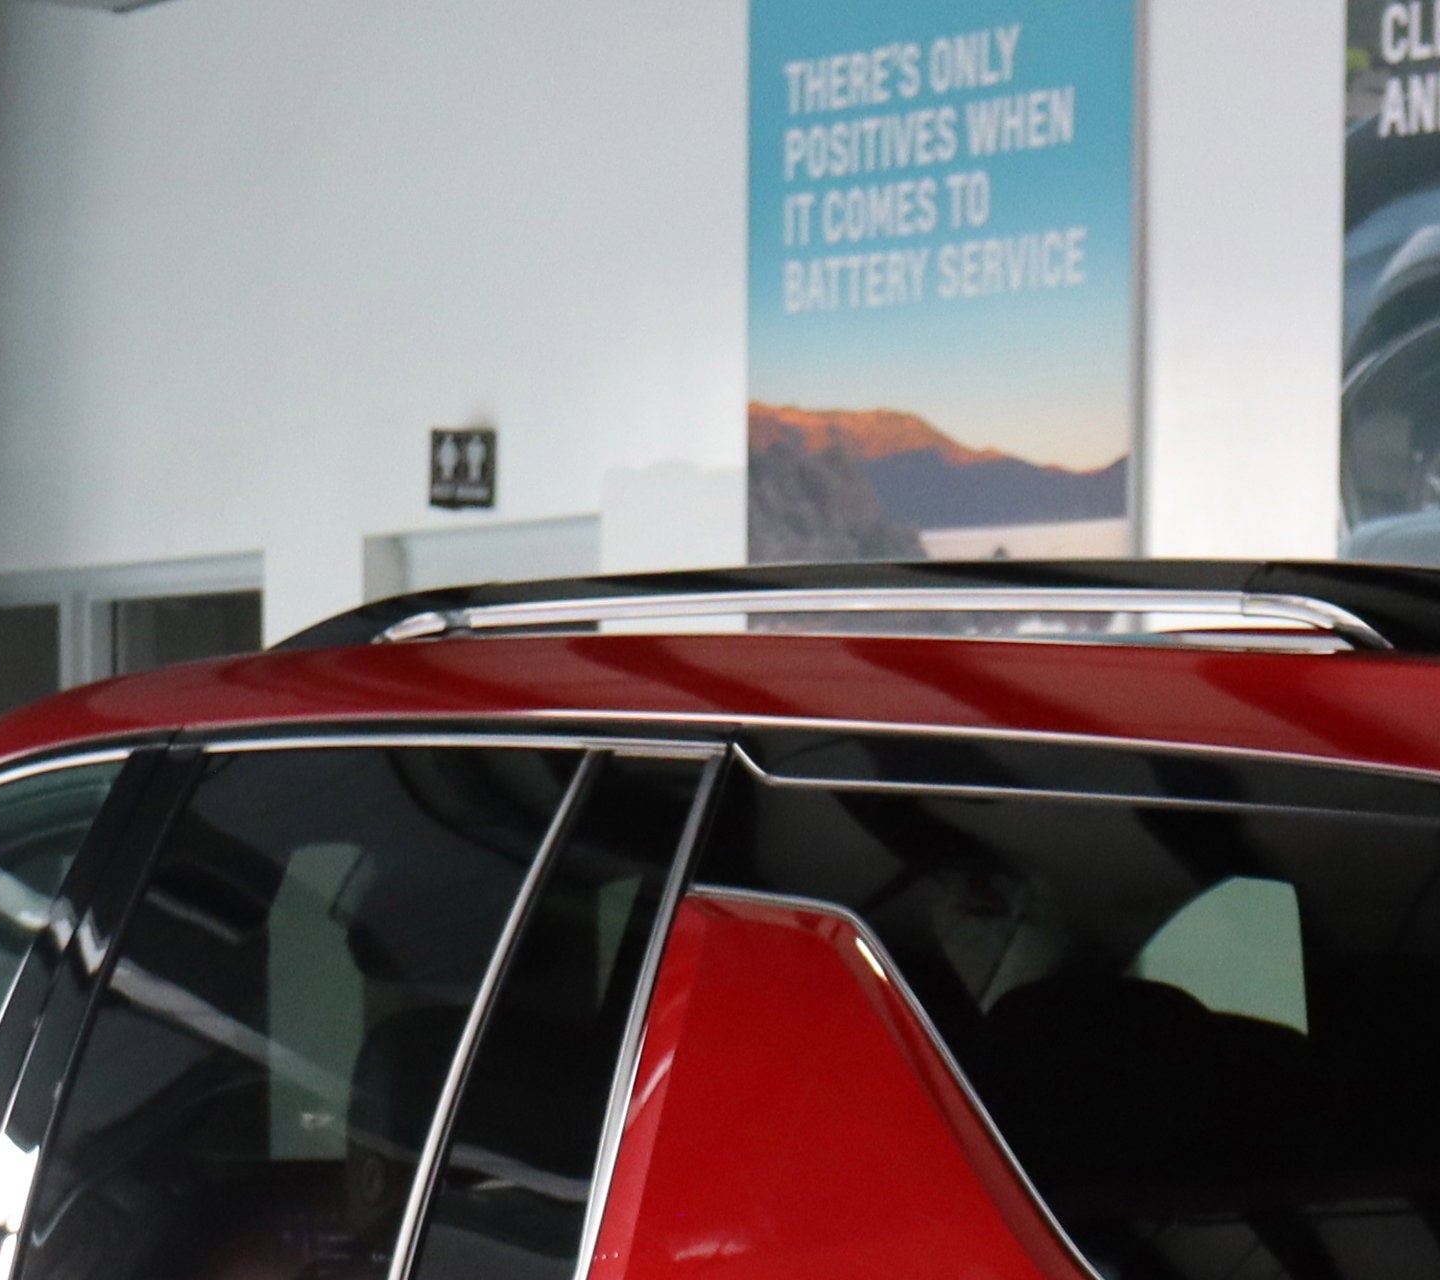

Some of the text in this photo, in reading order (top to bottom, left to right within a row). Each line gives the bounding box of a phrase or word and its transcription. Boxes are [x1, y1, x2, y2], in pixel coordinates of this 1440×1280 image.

[784, 24, 1021, 115] THERE'S ONLY
[784, 86, 1074, 182] POSITIVES WHEN
[783, 170, 991, 247] IT COMES TO
[783, 226, 1088, 315] BATTERY SERVICE
